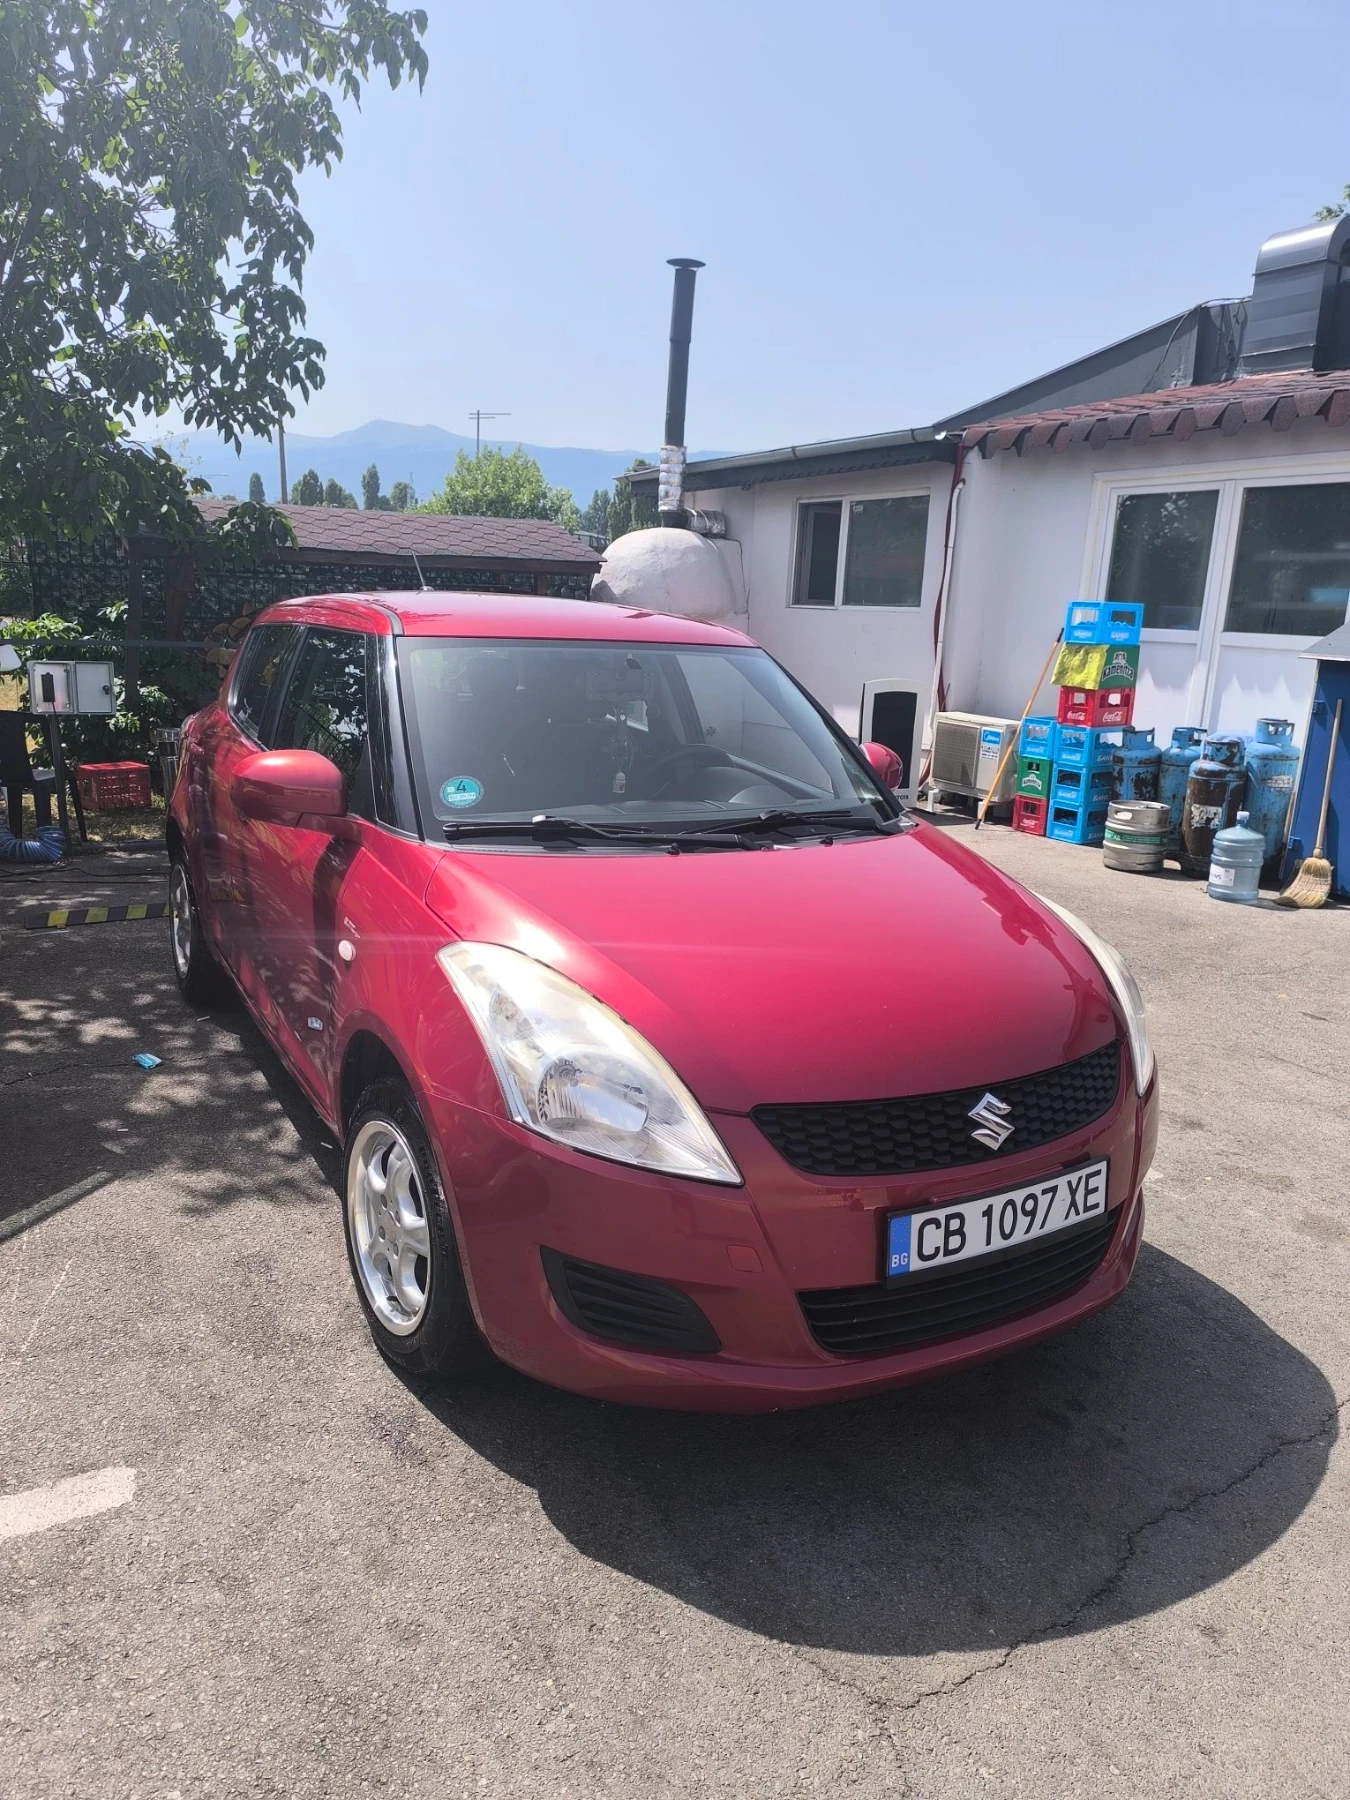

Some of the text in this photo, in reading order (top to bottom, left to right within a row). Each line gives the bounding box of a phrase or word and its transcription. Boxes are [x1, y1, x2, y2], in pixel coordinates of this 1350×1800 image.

[456, 780, 467, 791] 4
[917, 1169, 1102, 1263] CB 1097 XE
[891, 1252, 908, 1269] BG
